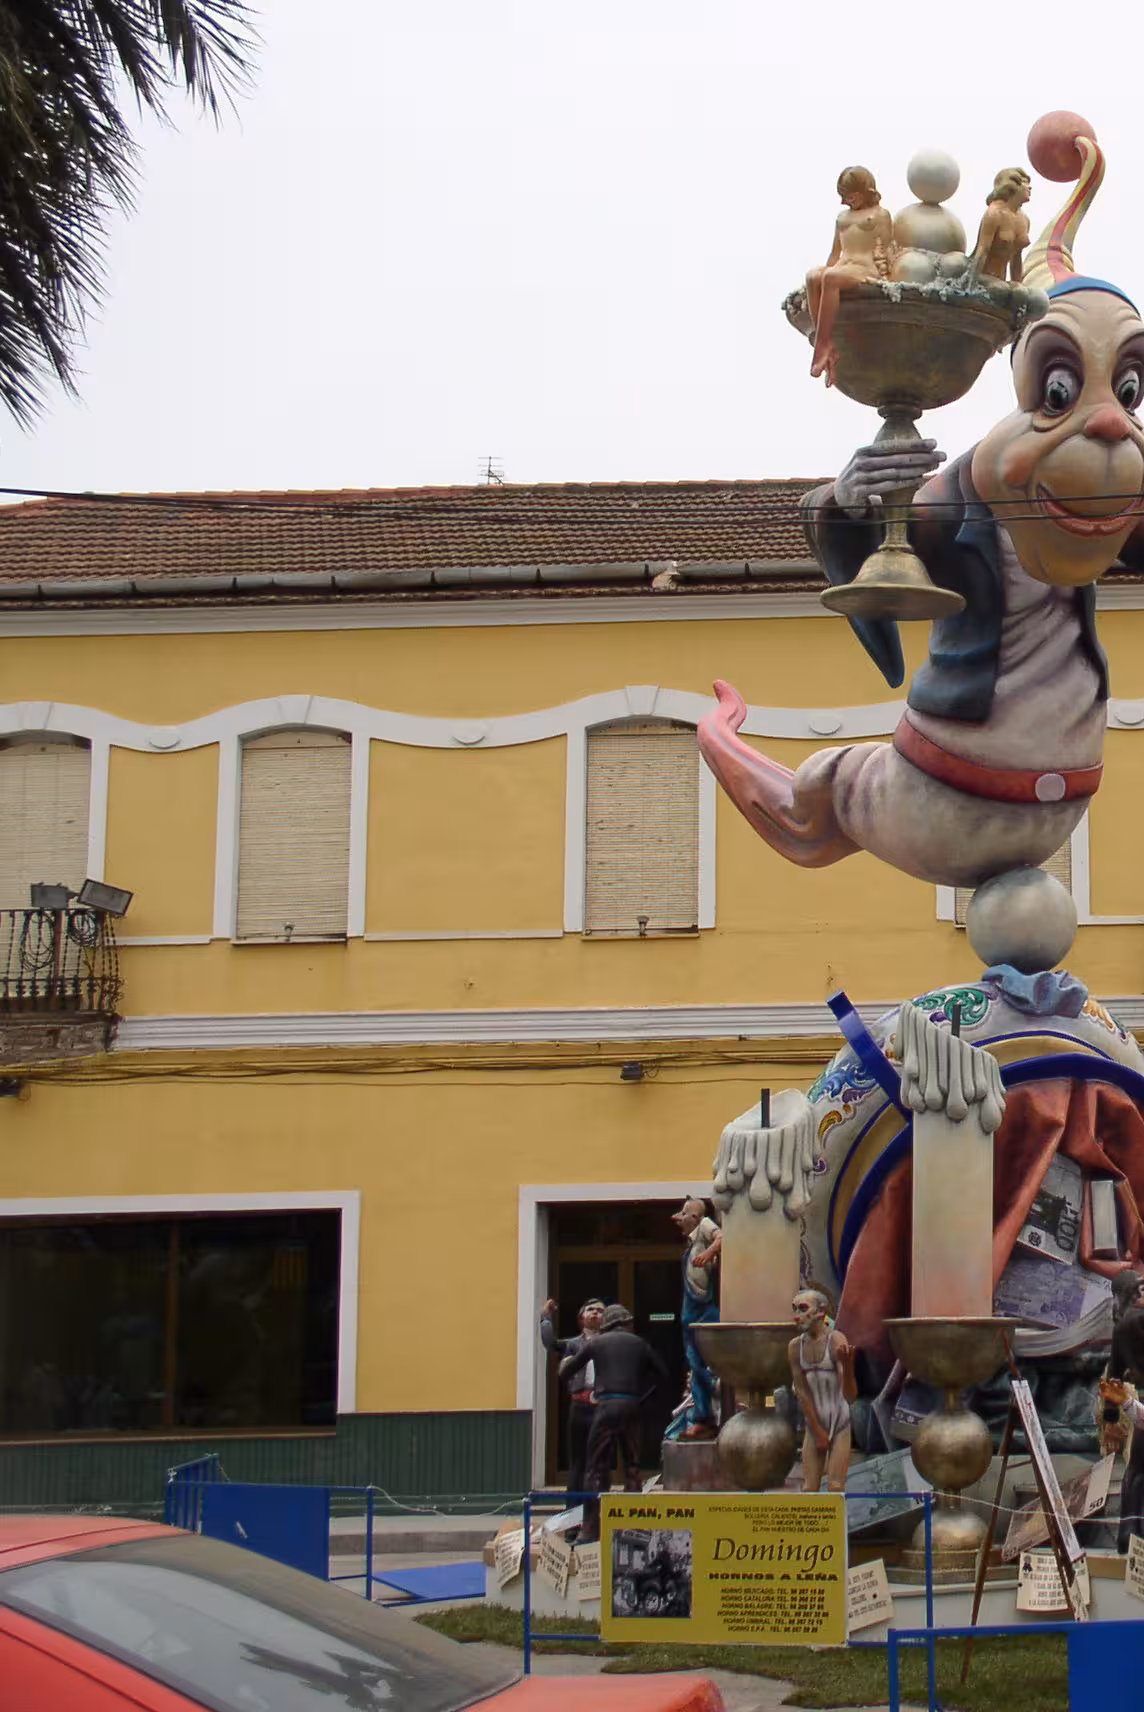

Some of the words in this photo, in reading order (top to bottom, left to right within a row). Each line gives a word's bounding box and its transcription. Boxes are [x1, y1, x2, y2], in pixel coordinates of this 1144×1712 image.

[608, 1508, 624, 1518] AL
[628, 1508, 662, 1520] PAN,
[666, 1508, 695, 1518] PAN
[712, 1537, 834, 1573] Domingo
[780, 1573, 792, 1581] A
